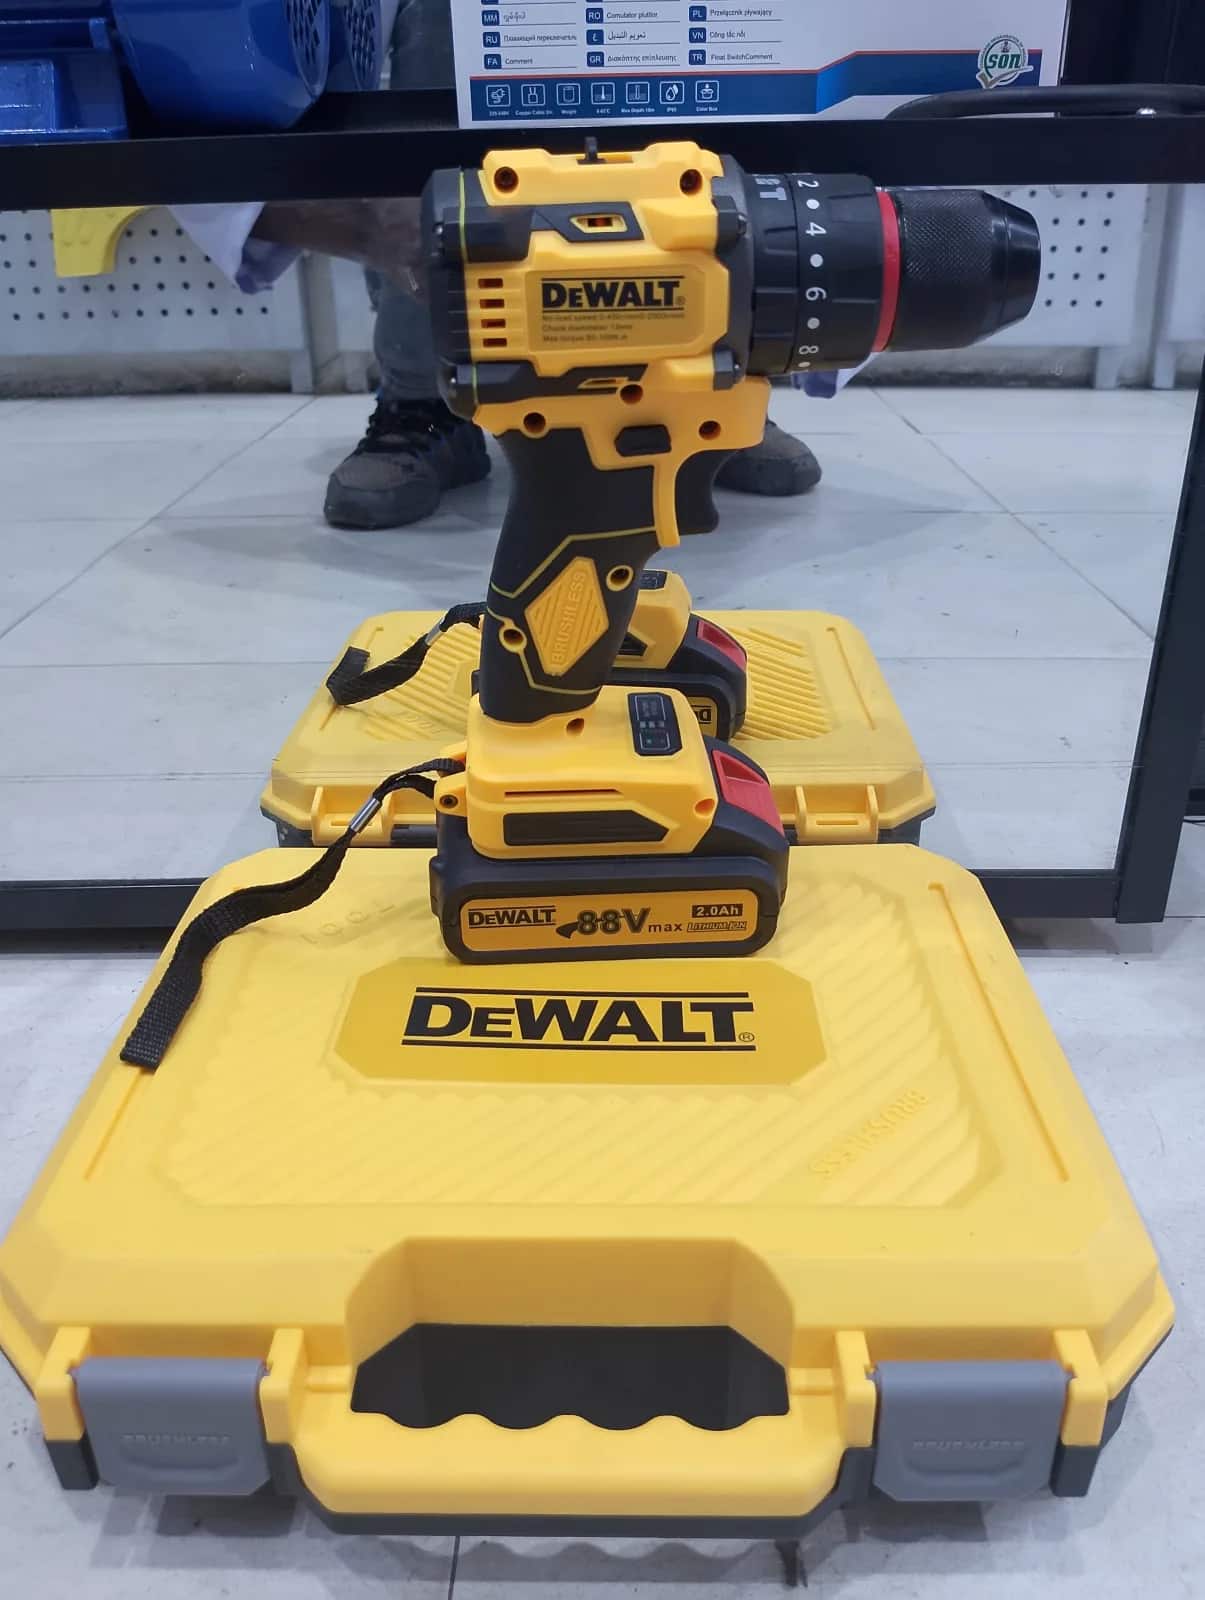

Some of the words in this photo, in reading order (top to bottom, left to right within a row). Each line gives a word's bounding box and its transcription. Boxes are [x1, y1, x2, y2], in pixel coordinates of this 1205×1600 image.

[588, 12, 601, 20] RO
[692, 9, 703, 18] PL
[484, 14, 498, 25] MM
[485, 35, 498, 44] RU
[692, 31, 704, 40] VN
[692, 53, 704, 62] TR
[797, 179, 820, 189] 2
[805, 221, 827, 237] 4
[541, 280, 681, 309] DEWALT
[805, 286, 827, 301] 6
[798, 345, 820, 355] 8
[551, 569, 587, 665] BRUSHLESS
[695, 904, 740, 918] 2.0Ah
[468, 908, 557, 927] DEWALT
[576, 908, 652, 935] 88V
[648, 922, 683, 933] max
[403, 994, 756, 1044] DEWALT
